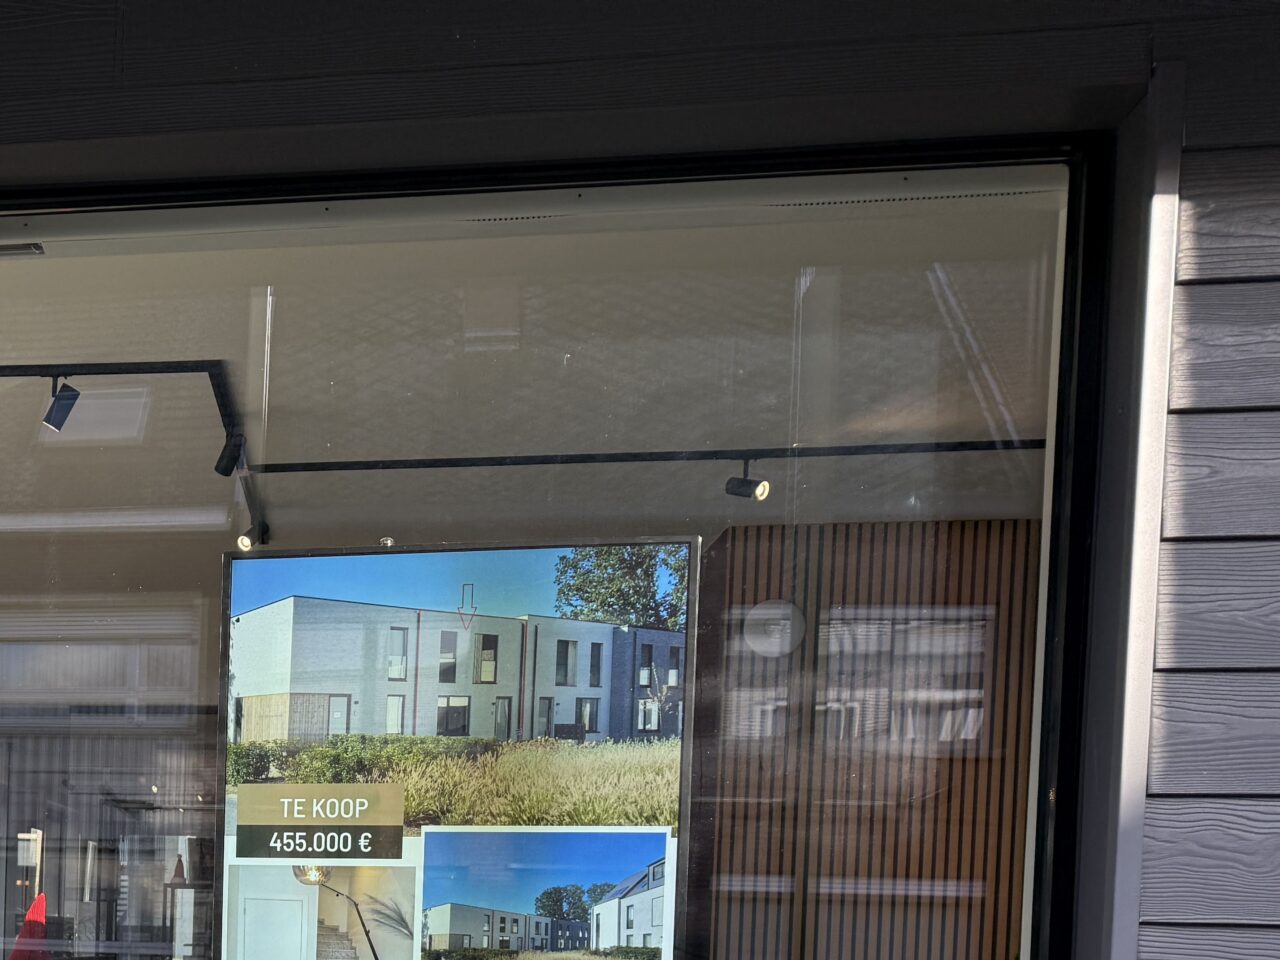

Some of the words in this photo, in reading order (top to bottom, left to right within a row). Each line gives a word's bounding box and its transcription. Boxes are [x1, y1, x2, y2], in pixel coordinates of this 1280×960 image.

[279, 798, 306, 818] TE
[312, 798, 369, 818] KOOP
[269, 831, 352, 852] 455.000
[358, 832, 372, 852] €
